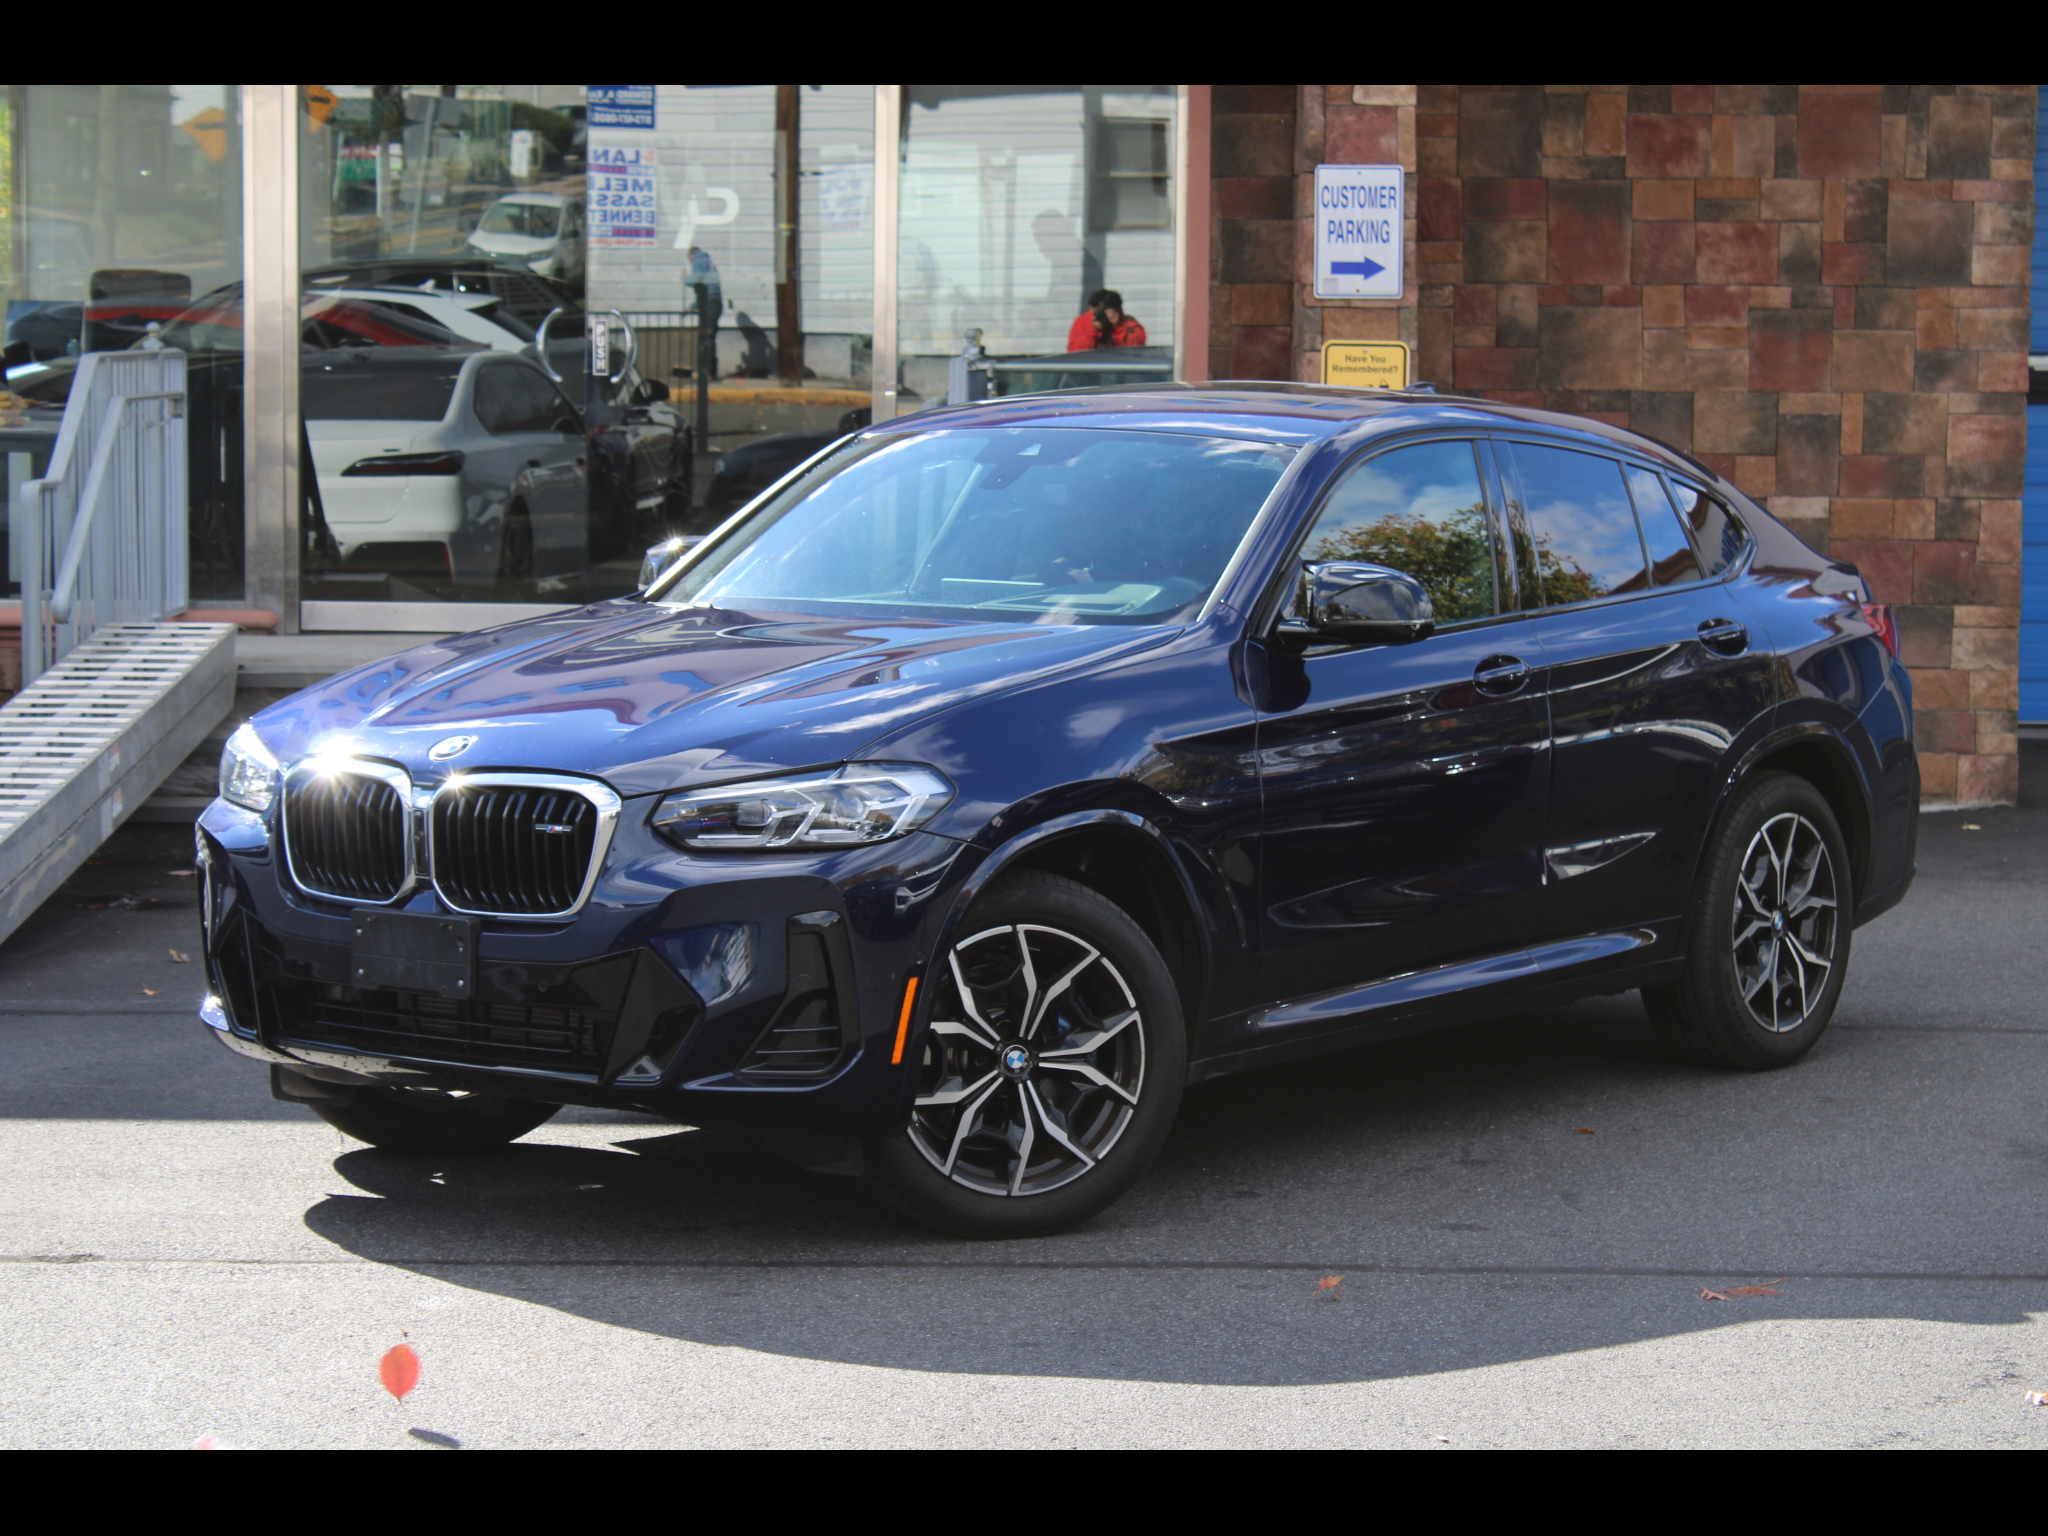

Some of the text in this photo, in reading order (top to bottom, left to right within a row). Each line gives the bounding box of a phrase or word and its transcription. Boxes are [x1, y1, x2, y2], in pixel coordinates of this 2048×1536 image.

[1321, 185, 1397, 209] CUSTOMER
[1327, 219, 1390, 244] PARKING
[596, 324, 605, 370] PUSH
[1345, 354, 1387, 363] Have You
[1332, 364, 1399, 374] Remembered?
